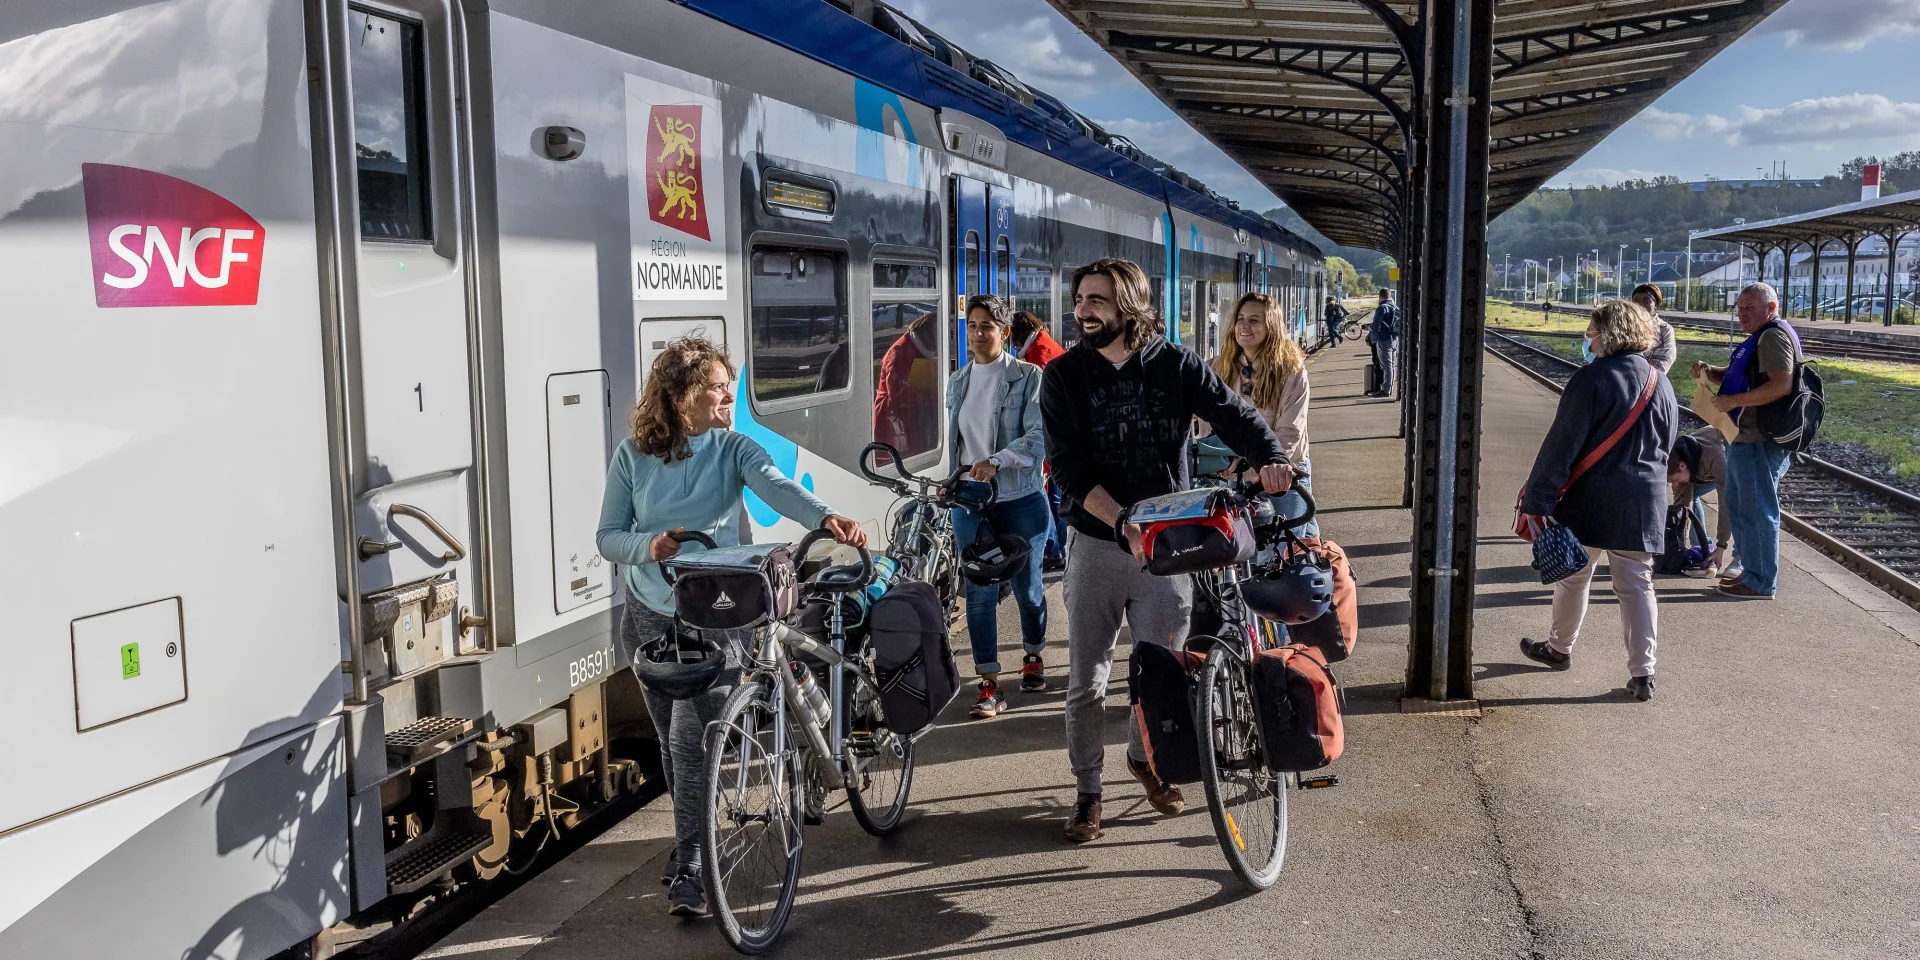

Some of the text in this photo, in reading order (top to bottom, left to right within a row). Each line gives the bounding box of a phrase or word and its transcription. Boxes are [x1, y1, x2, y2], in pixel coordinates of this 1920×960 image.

[103, 224, 254, 289] SNCF
[651, 236, 686, 257] RÉGION
[637, 261, 723, 290] NORMANDIE
[414, 382, 423, 412] 1
[536, 674, 542, 685] A
[569, 643, 616, 688] B85911
